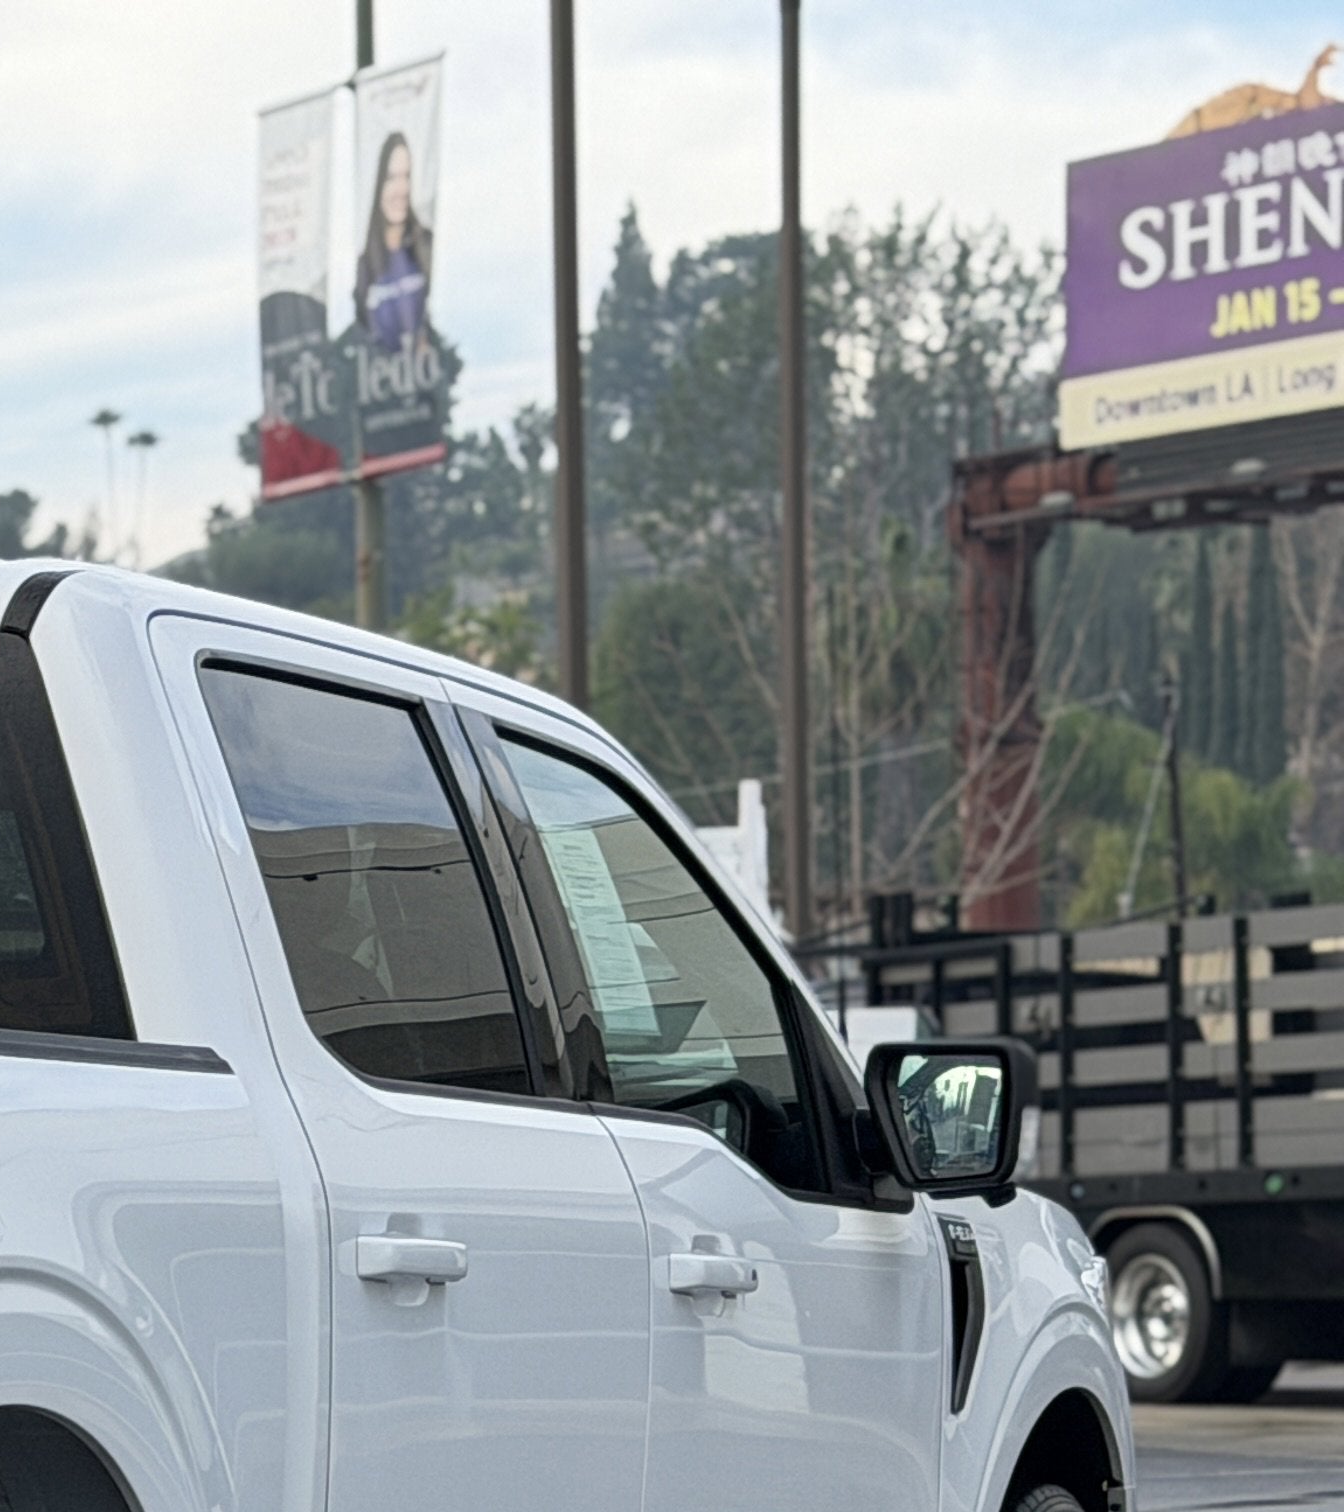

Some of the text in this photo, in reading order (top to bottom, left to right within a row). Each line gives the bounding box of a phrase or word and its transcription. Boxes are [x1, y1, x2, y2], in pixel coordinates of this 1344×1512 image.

[1118, 167, 1344, 289] SHEN
[1210, 277, 1321, 338] JAN 15
[1226, 373, 1255, 404] LA
